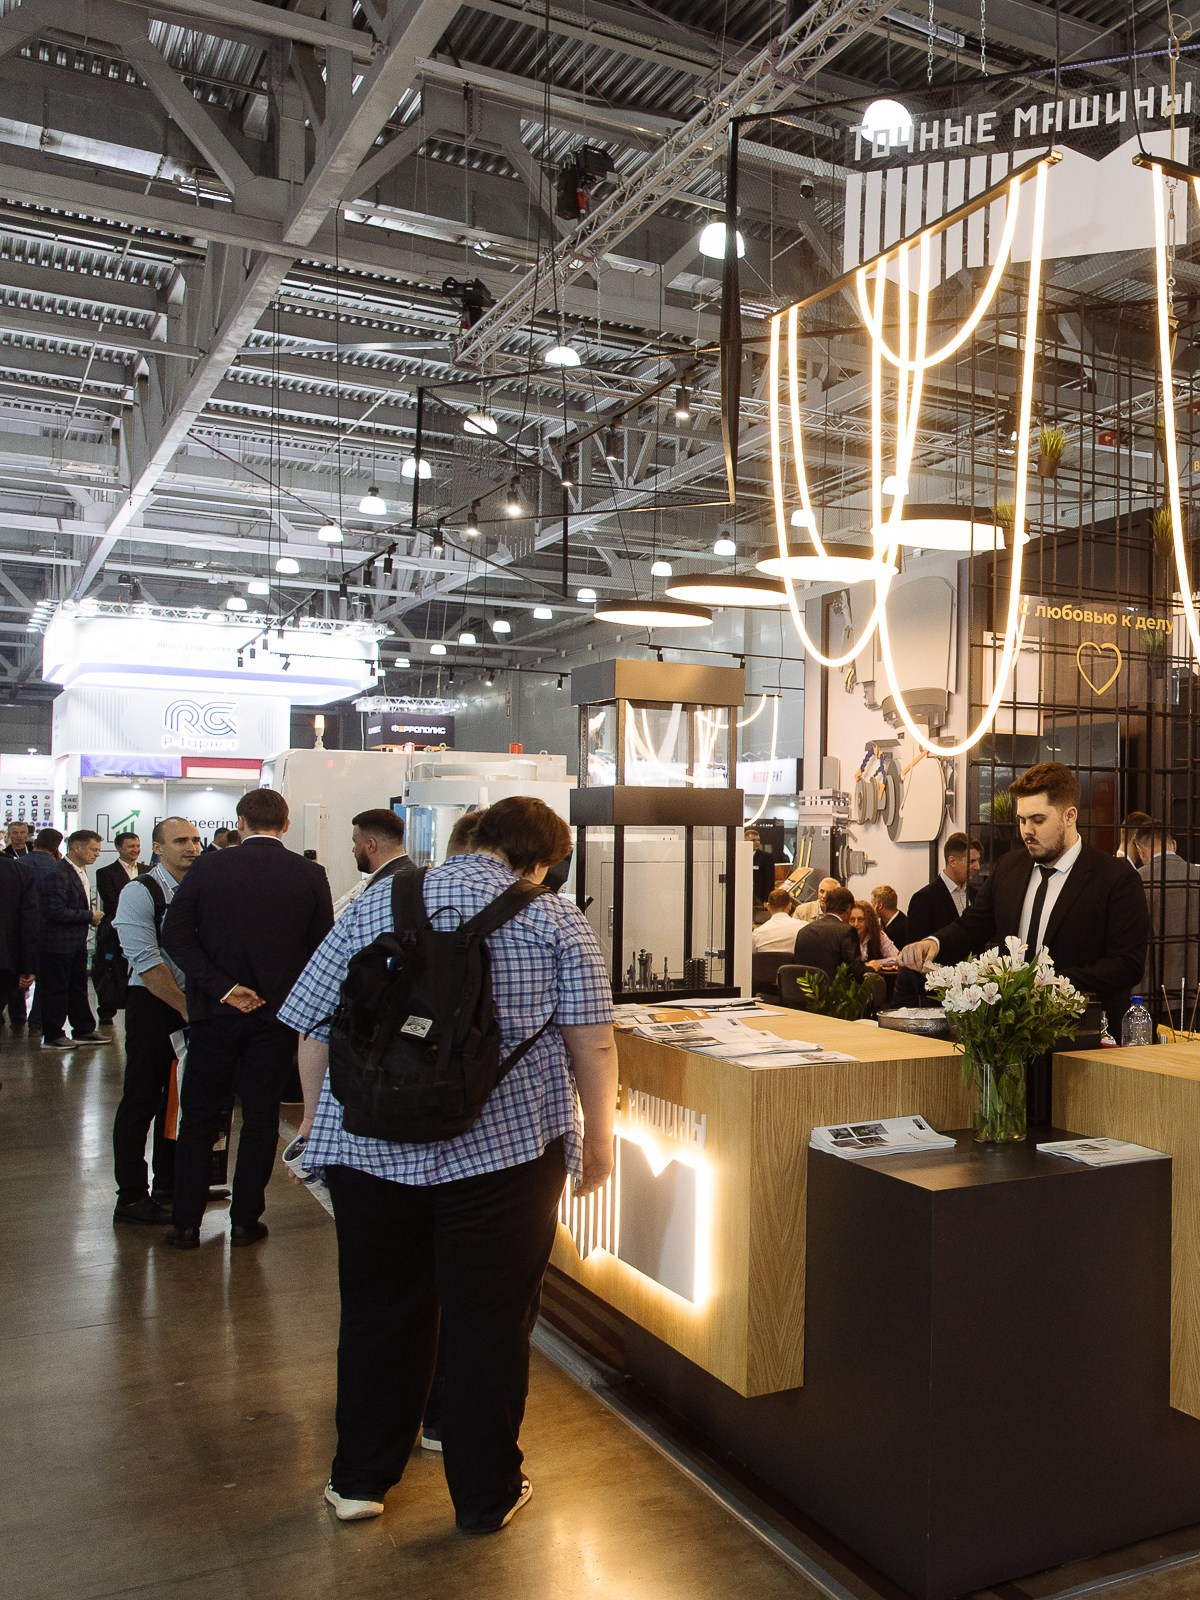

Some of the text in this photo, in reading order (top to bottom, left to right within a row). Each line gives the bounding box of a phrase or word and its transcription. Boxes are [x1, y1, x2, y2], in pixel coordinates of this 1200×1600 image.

[1035, 604, 1117, 625] любовью
[1121, 614, 1132, 628] к
[1135, 616, 1175, 635] делу
